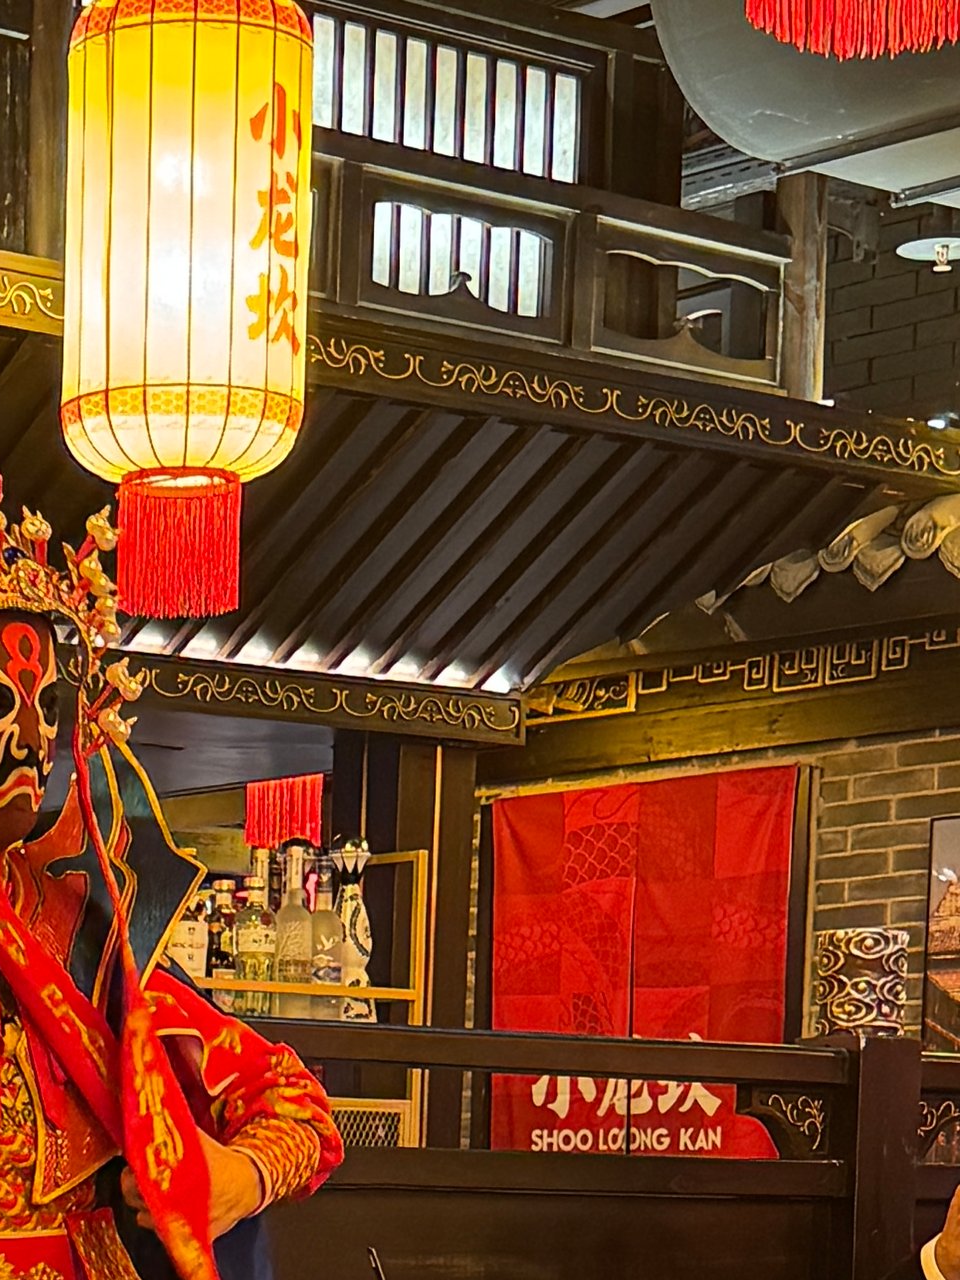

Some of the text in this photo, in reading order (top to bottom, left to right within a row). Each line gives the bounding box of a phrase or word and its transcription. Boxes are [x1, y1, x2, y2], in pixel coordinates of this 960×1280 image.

[246, 81, 301, 356] 小龙坎
[531, 1128, 593, 1152] SHOO
[679, 1126, 722, 1151] KAN
